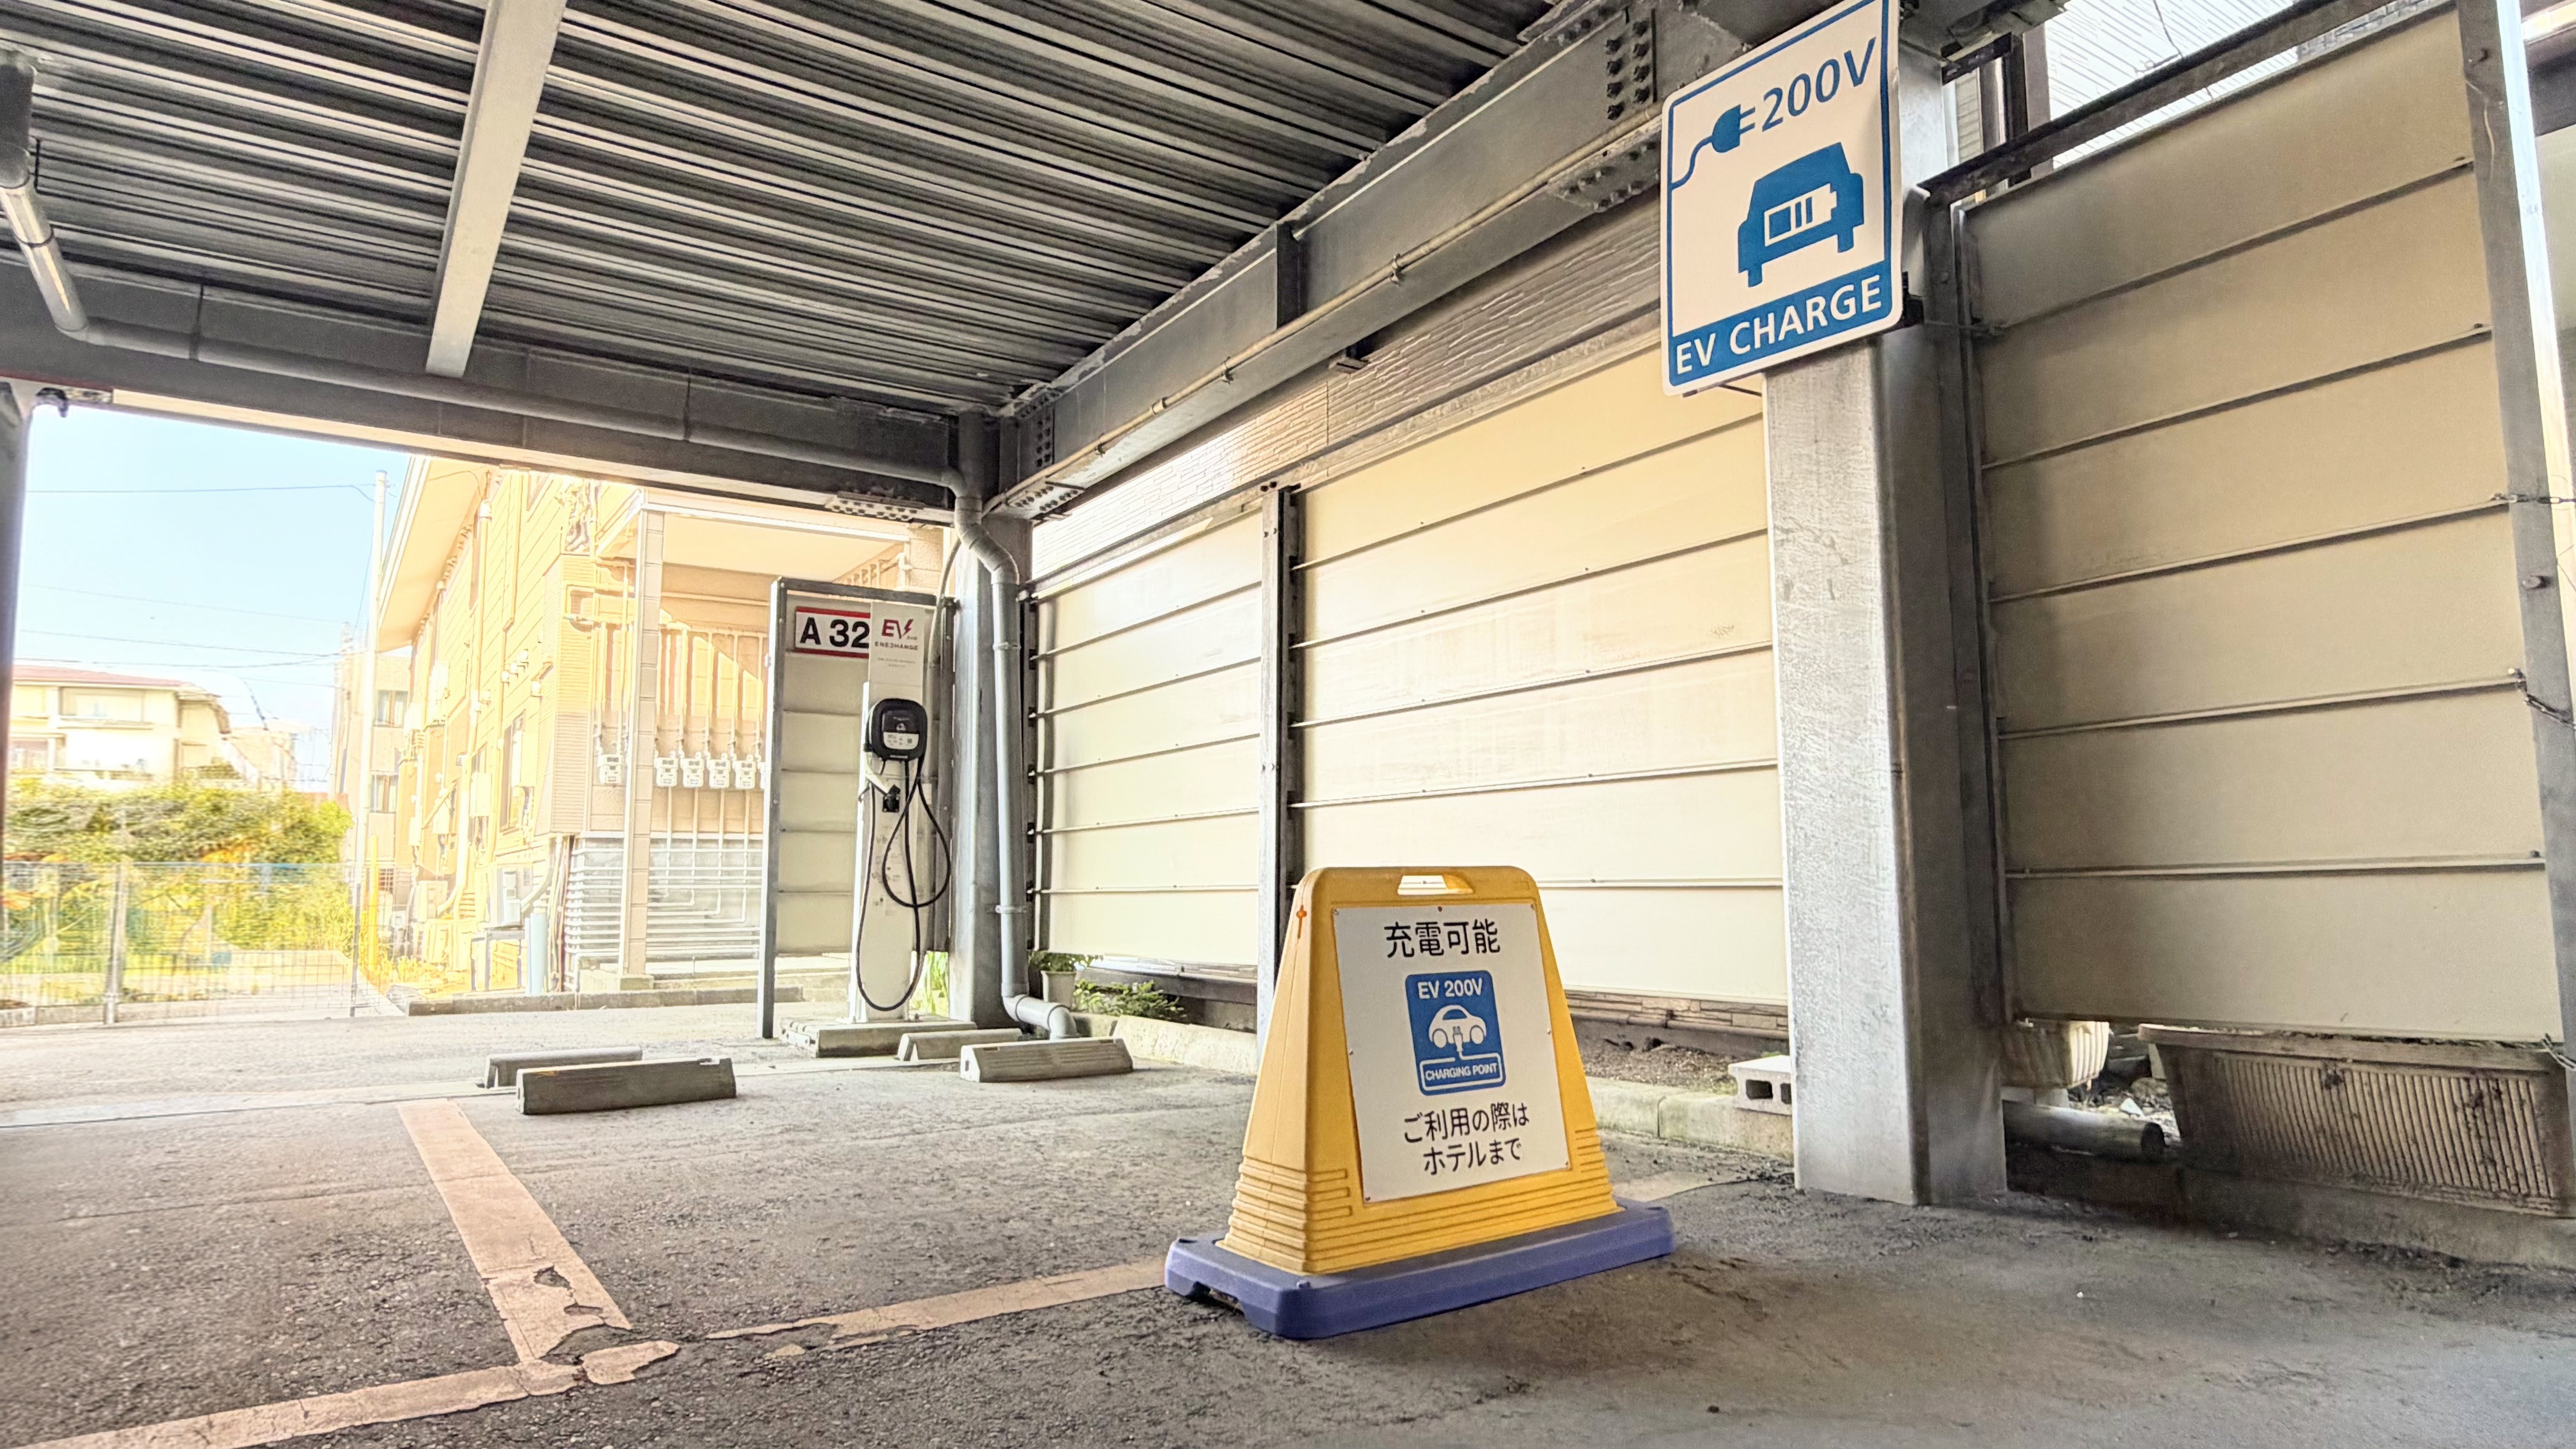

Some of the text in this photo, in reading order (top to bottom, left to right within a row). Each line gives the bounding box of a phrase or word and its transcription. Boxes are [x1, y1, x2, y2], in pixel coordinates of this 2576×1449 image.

[1762, 37, 1876, 132] 200V
[1675, 274, 1882, 375] EV CHARGE
[799, 616, 870, 649] A 32
[882, 618, 914, 639] EV
[1384, 919, 1500, 958] 充電可能
[1417, 977, 1483, 999] EV 200V
[1425, 1063, 1498, 1081] CHARGING POINT
[1404, 1102, 1529, 1143] ご利用の際は
[1423, 1136, 1522, 1175] ホテルまで
